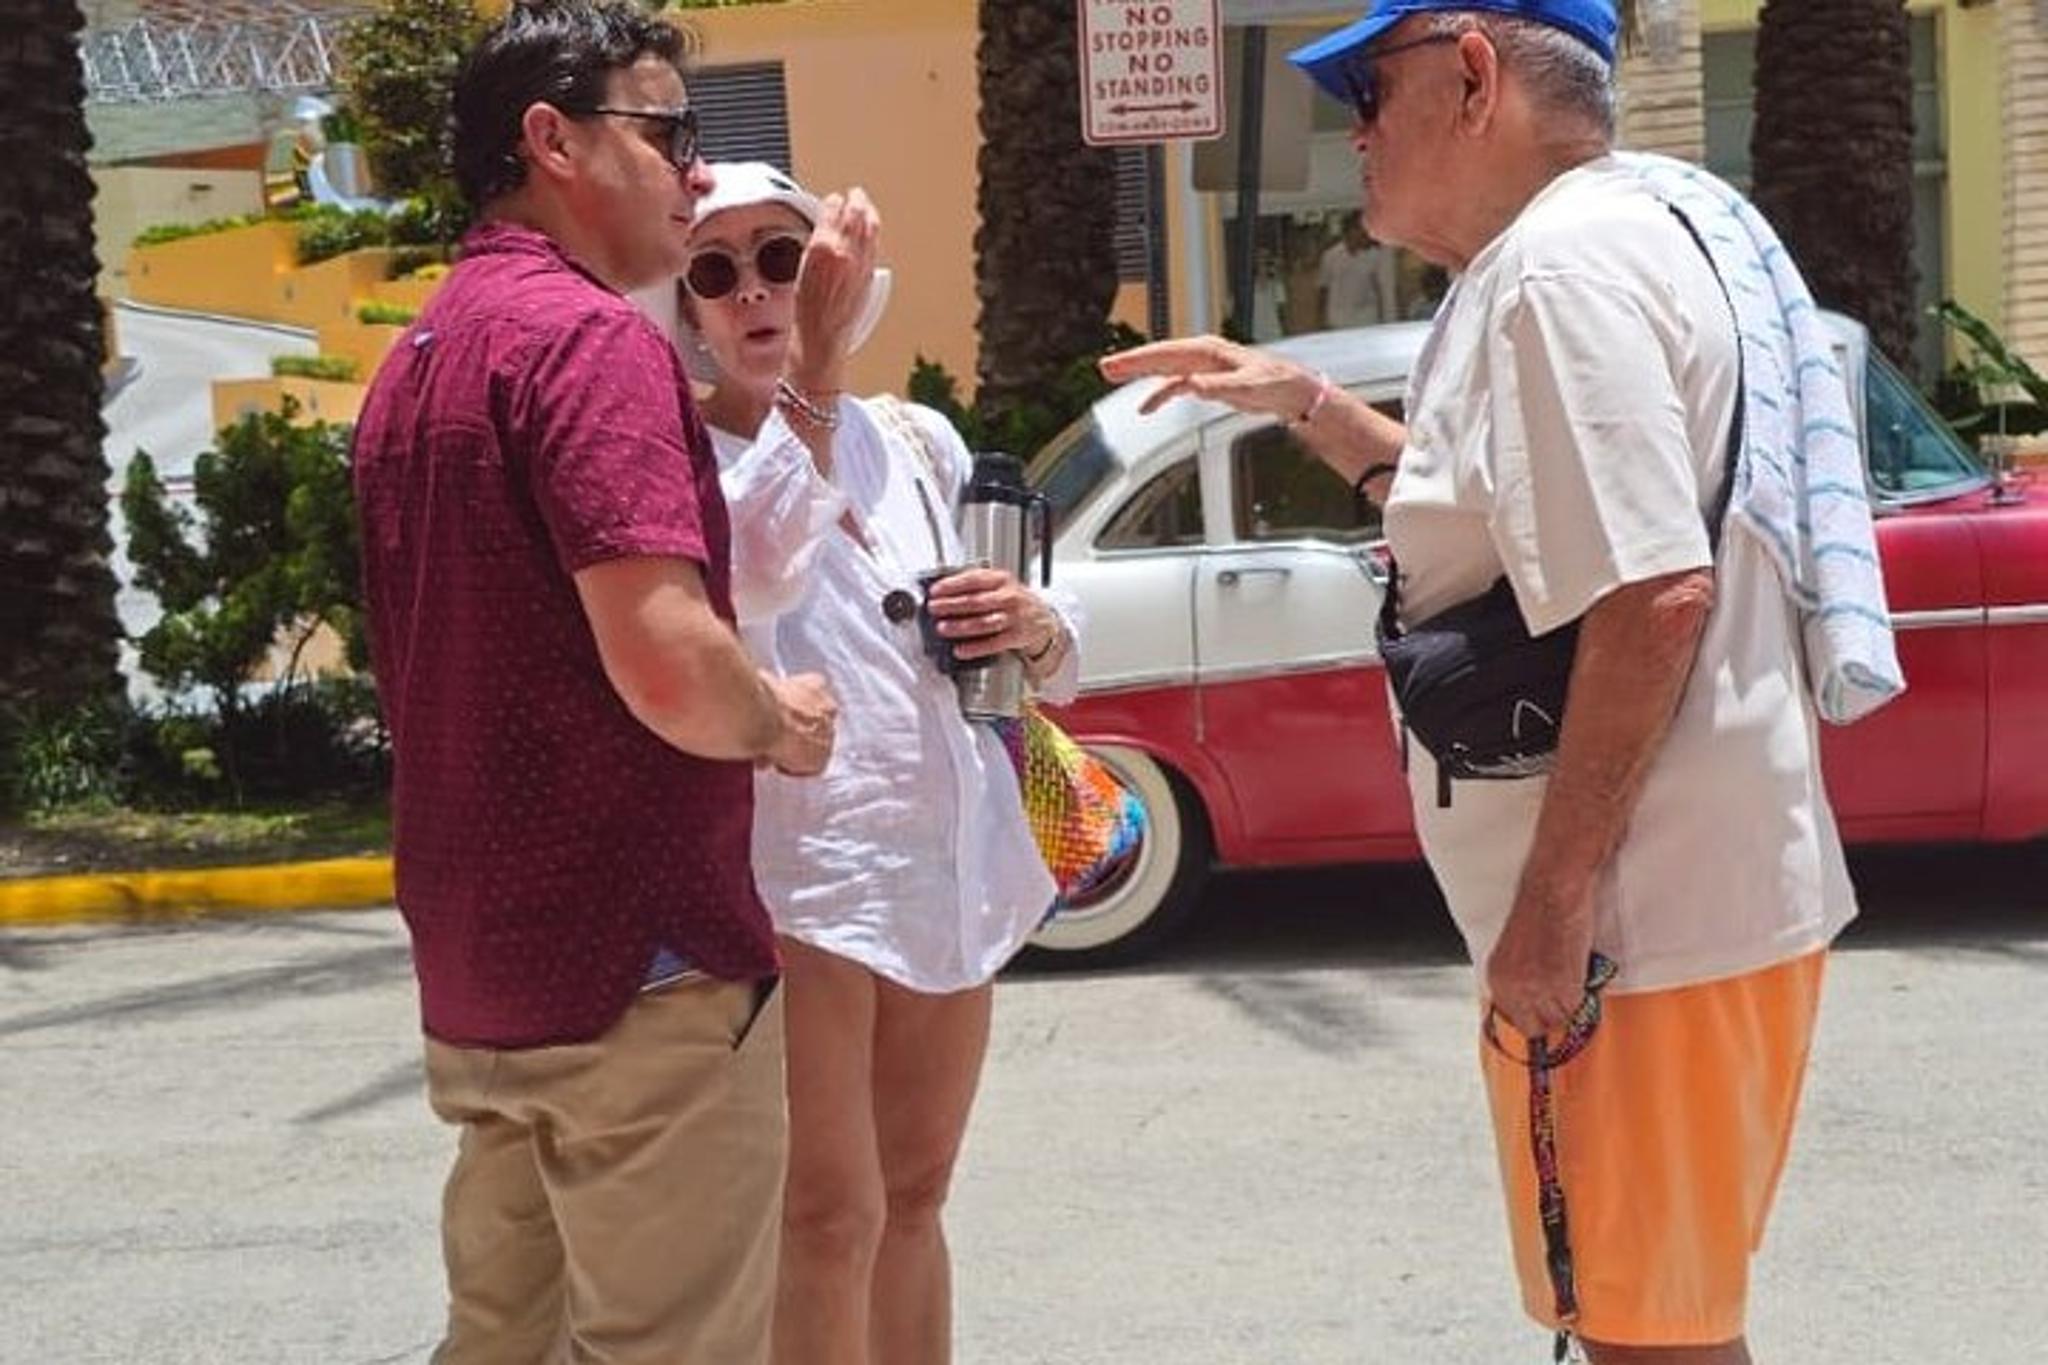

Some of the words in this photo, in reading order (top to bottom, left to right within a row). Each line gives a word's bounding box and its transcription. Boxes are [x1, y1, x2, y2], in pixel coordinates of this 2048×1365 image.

[1126, 6, 1172, 26] NO
[1093, 27, 1209, 52] STOPPING
[1129, 53, 1173, 74] NO
[1095, 74, 1209, 100] STANDING
